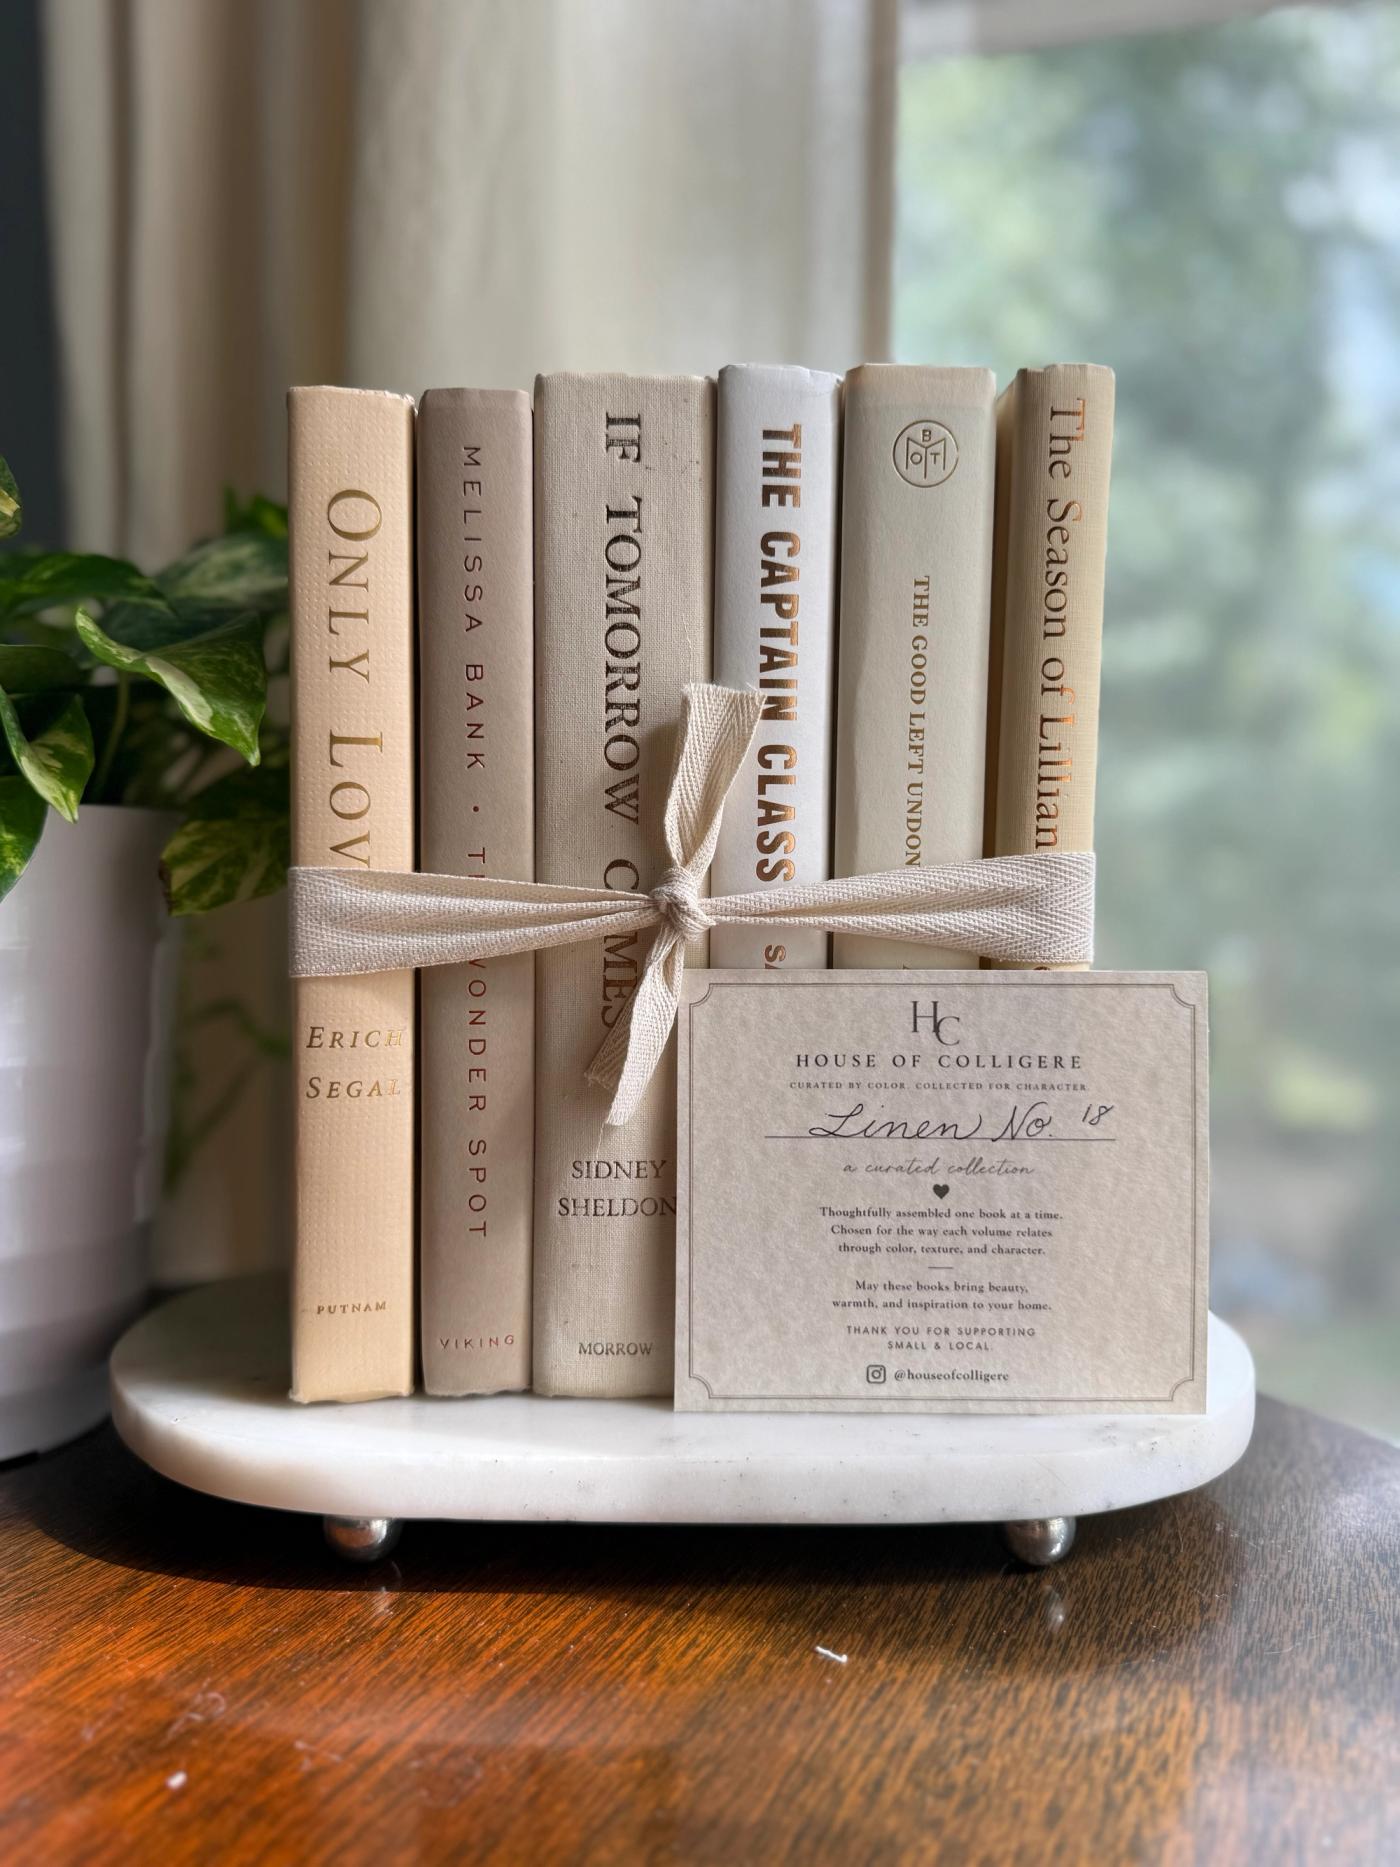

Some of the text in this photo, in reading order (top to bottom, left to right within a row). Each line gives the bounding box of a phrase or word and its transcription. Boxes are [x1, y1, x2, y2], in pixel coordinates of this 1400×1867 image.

[462, 446, 485, 770] MELISSA BANK
[1035, 397, 1088, 850] The Season of Lillian
[755, 422, 802, 883] THE CAPTAIN CLASS
[326, 488, 385, 869] ONLY LOV
[601, 412, 643, 1029] IF TOMORROW CMES
[905, 575, 931, 867] THE GOOD LEFT UNDON
[305, 1025, 403, 1049] ERICH
[796, 1054, 1083, 1070] HOUSE OF COLLIGERE
[305, 1076, 402, 1099] SEGAL
[789, 1081, 842, 1089] CURATED
[849, 1081, 861, 1089] BY
[915, 1082, 983, 1090] COLLECTED
[989, 1082, 1010, 1091] FOR
[808, 1101, 1114, 1142] Linen No. 18
[571, 1160, 667, 1179] SIDNEY
[843, 1156, 1036, 1176] a curated collection
[467, 1139, 487, 1238] SPOT
[558, 1197, 677, 1217] SHELDON
[819, 1206, 892, 1220] Thoughtfully
[896, 1208, 951, 1219] assembled
[955, 1211, 975, 1219] one
[979, 1208, 1006, 1220] book
[1011, 1211, 1021, 1220] at
[1035, 1210, 1063, 1220] time.
[831, 1224, 1053, 1238] Chosen for the way each volume relates
[838, 1242, 1046, 1256] through color, texture, and character.
[855, 1280, 1029, 1295] May these books bring beauty,
[317, 1301, 387, 1315] PUTNAM
[832, 1298, 1052, 1312] warmth, and inspiration to your home.
[846, 1325, 1035, 1337] THANK YOU FOR SUPPORTING
[440, 1334, 515, 1350] VIKING
[578, 1341, 653, 1357] MORROW
[887, 1340, 926, 1350] SMALL
[934, 1341, 941, 1350] &
[894, 1368, 1009, 1382] @houseofcolligere
